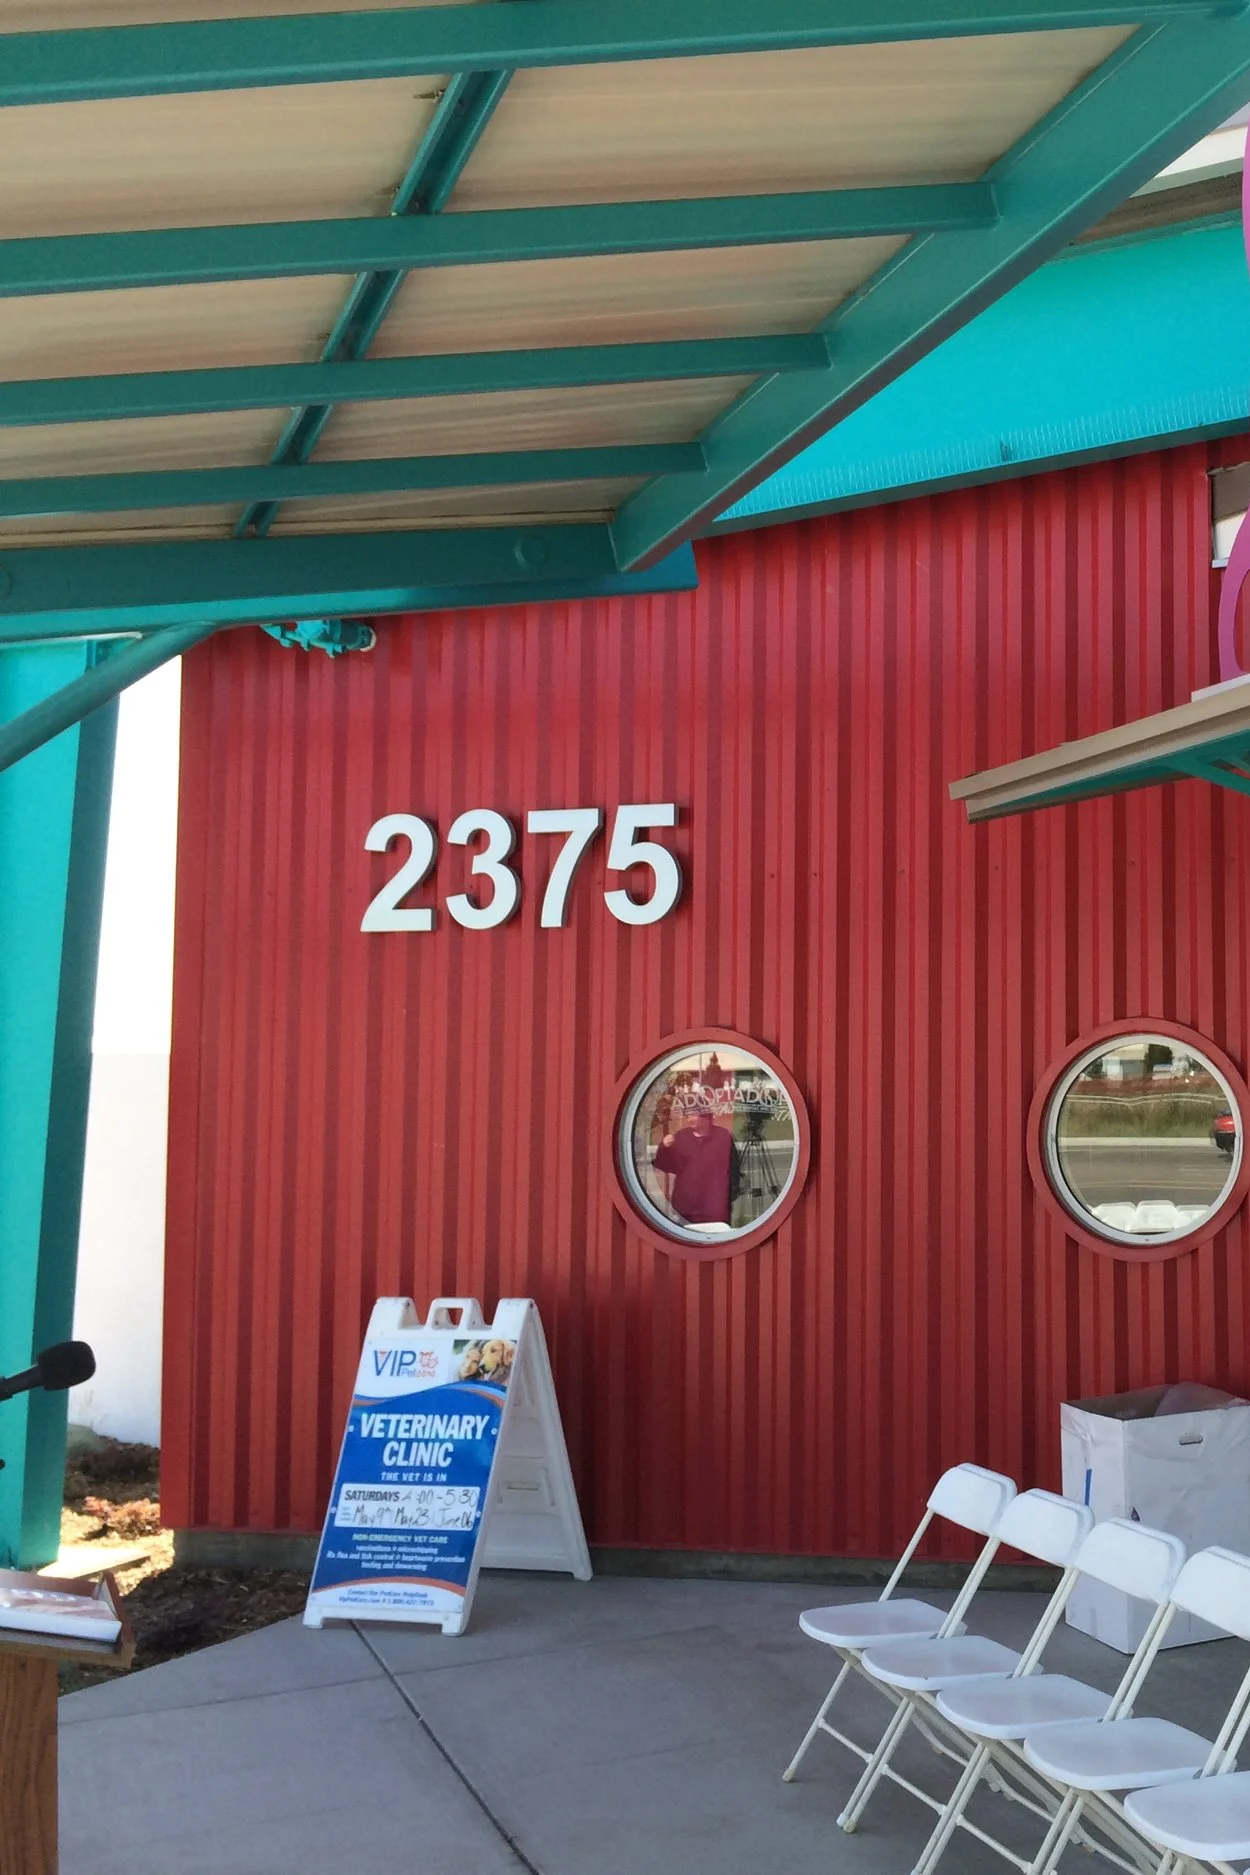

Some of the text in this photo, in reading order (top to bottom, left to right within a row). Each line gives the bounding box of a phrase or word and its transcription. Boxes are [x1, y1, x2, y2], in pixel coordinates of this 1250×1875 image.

[360, 803, 681, 932] 2375
[373, 1350, 417, 1377] VIP
[360, 1413, 490, 1440] VETERINARY
[382, 1440, 454, 1467] CLINIC
[380, 1471, 447, 1482] THE VET IS IN
[344, 1490, 400, 1502] SATURDAYS
